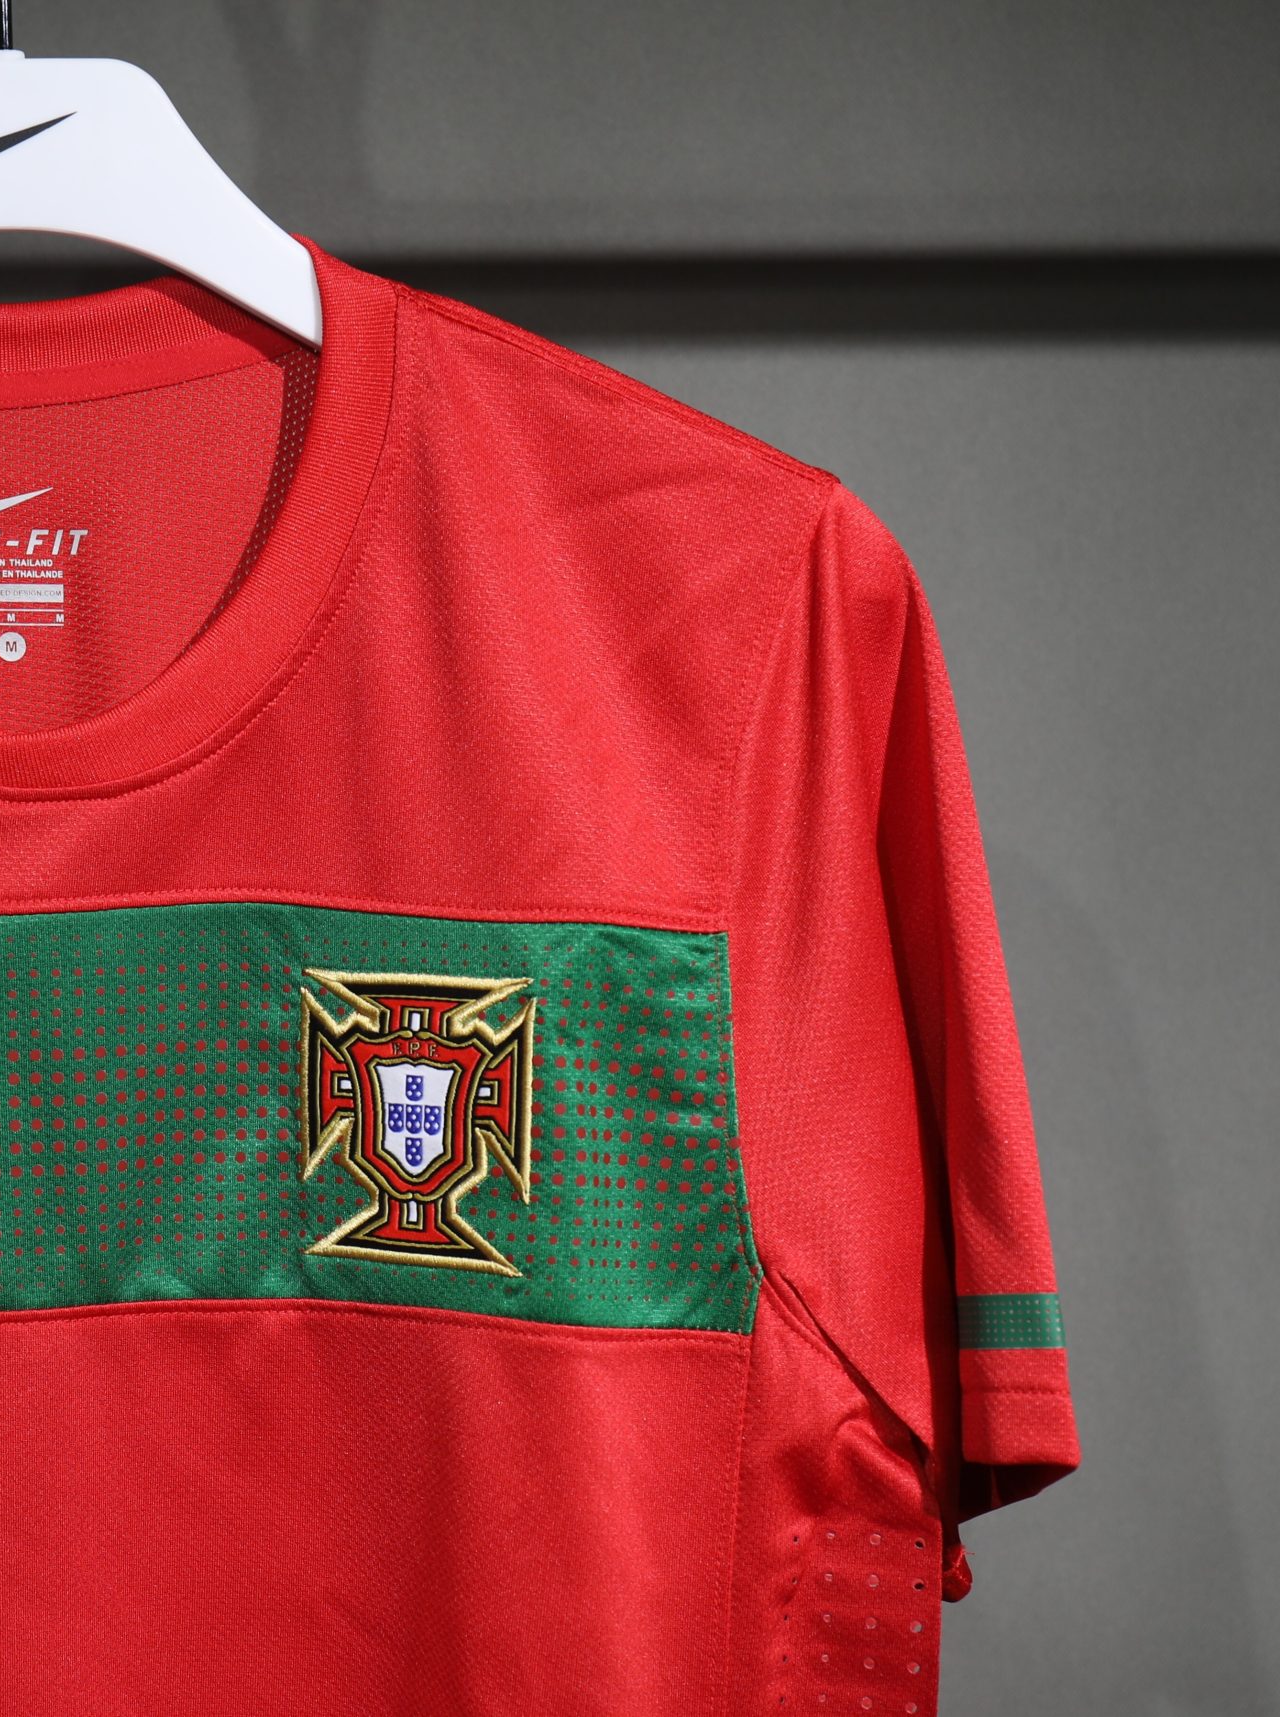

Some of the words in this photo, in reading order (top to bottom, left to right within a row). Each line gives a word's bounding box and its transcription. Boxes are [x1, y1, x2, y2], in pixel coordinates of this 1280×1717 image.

[9, 559, 53, 567] THAILAND
[3, 570, 13, 578] EN
[14, 570, 64, 579] THAILANDE
[7, 612, 16, 622] M
[55, 613, 64, 623] M
[5, 641, 18, 653] M
